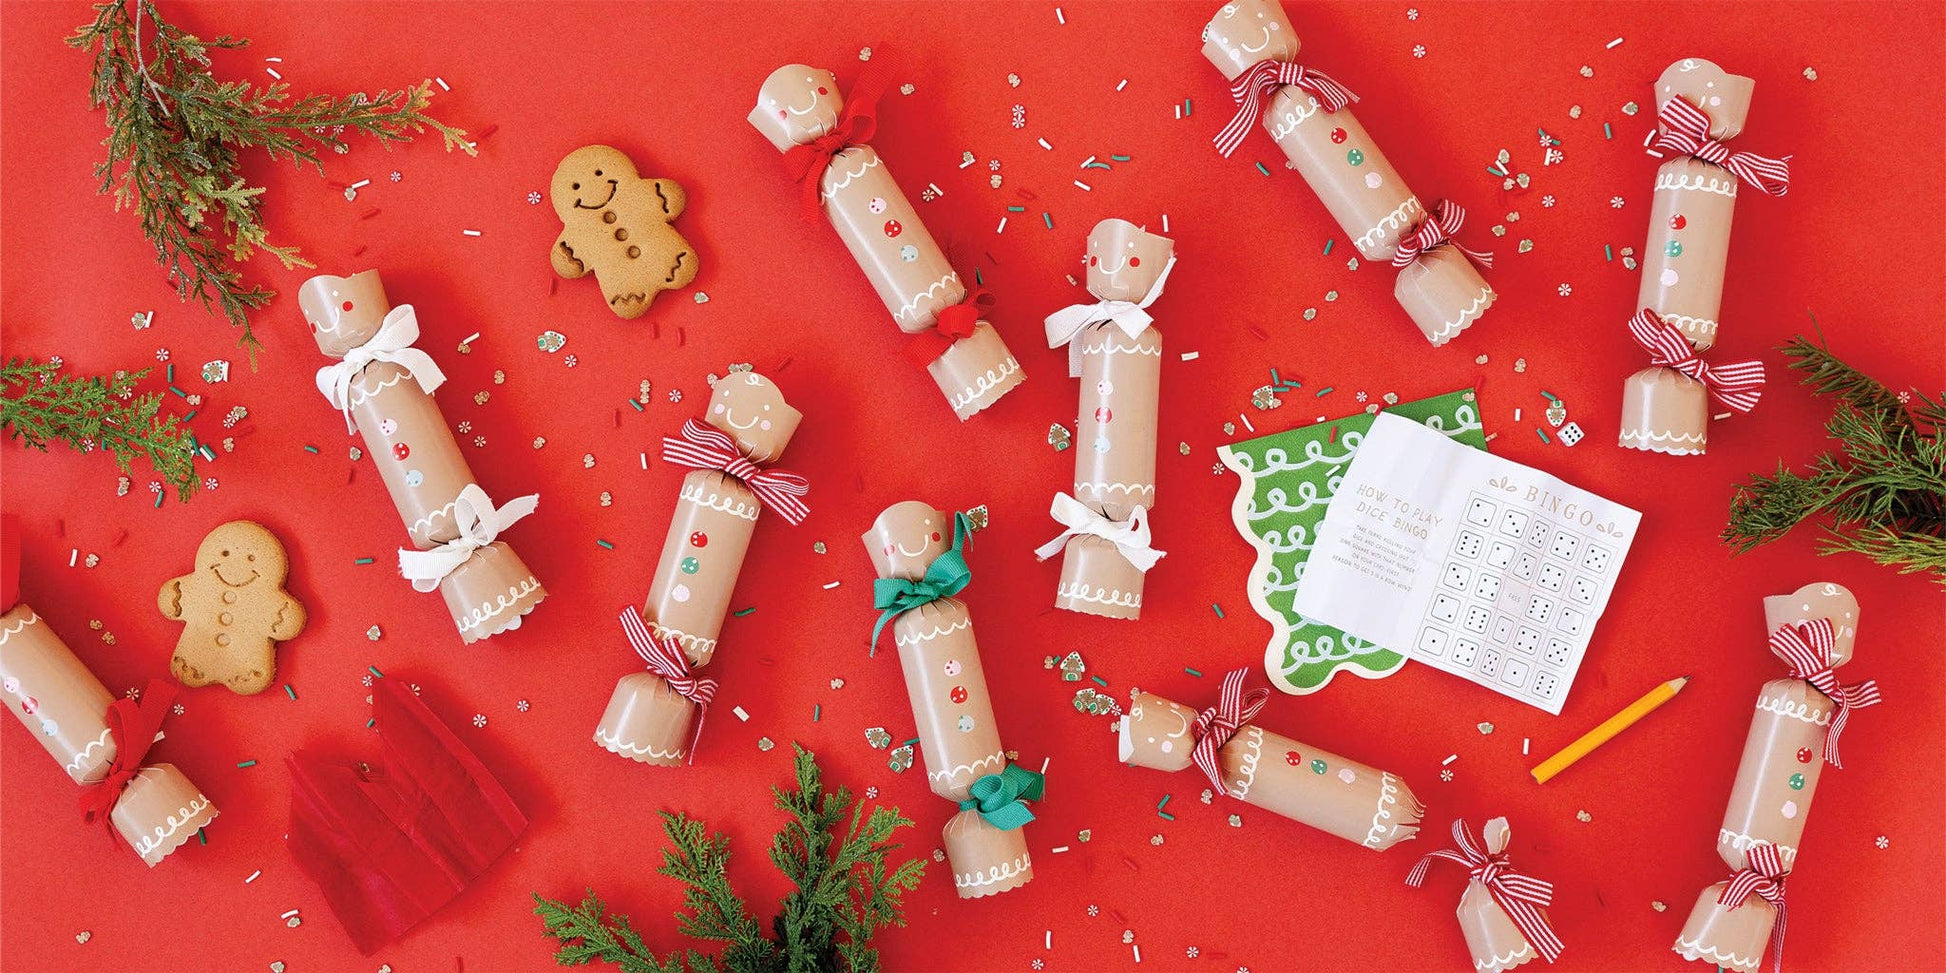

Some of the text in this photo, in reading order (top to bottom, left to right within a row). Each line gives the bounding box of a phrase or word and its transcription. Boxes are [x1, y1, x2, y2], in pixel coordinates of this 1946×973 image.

[1355, 501, 1428, 540] DICE BINGO
[1356, 484, 1443, 527] HOW TO PLAY
[1523, 485, 1593, 526] BINGO
